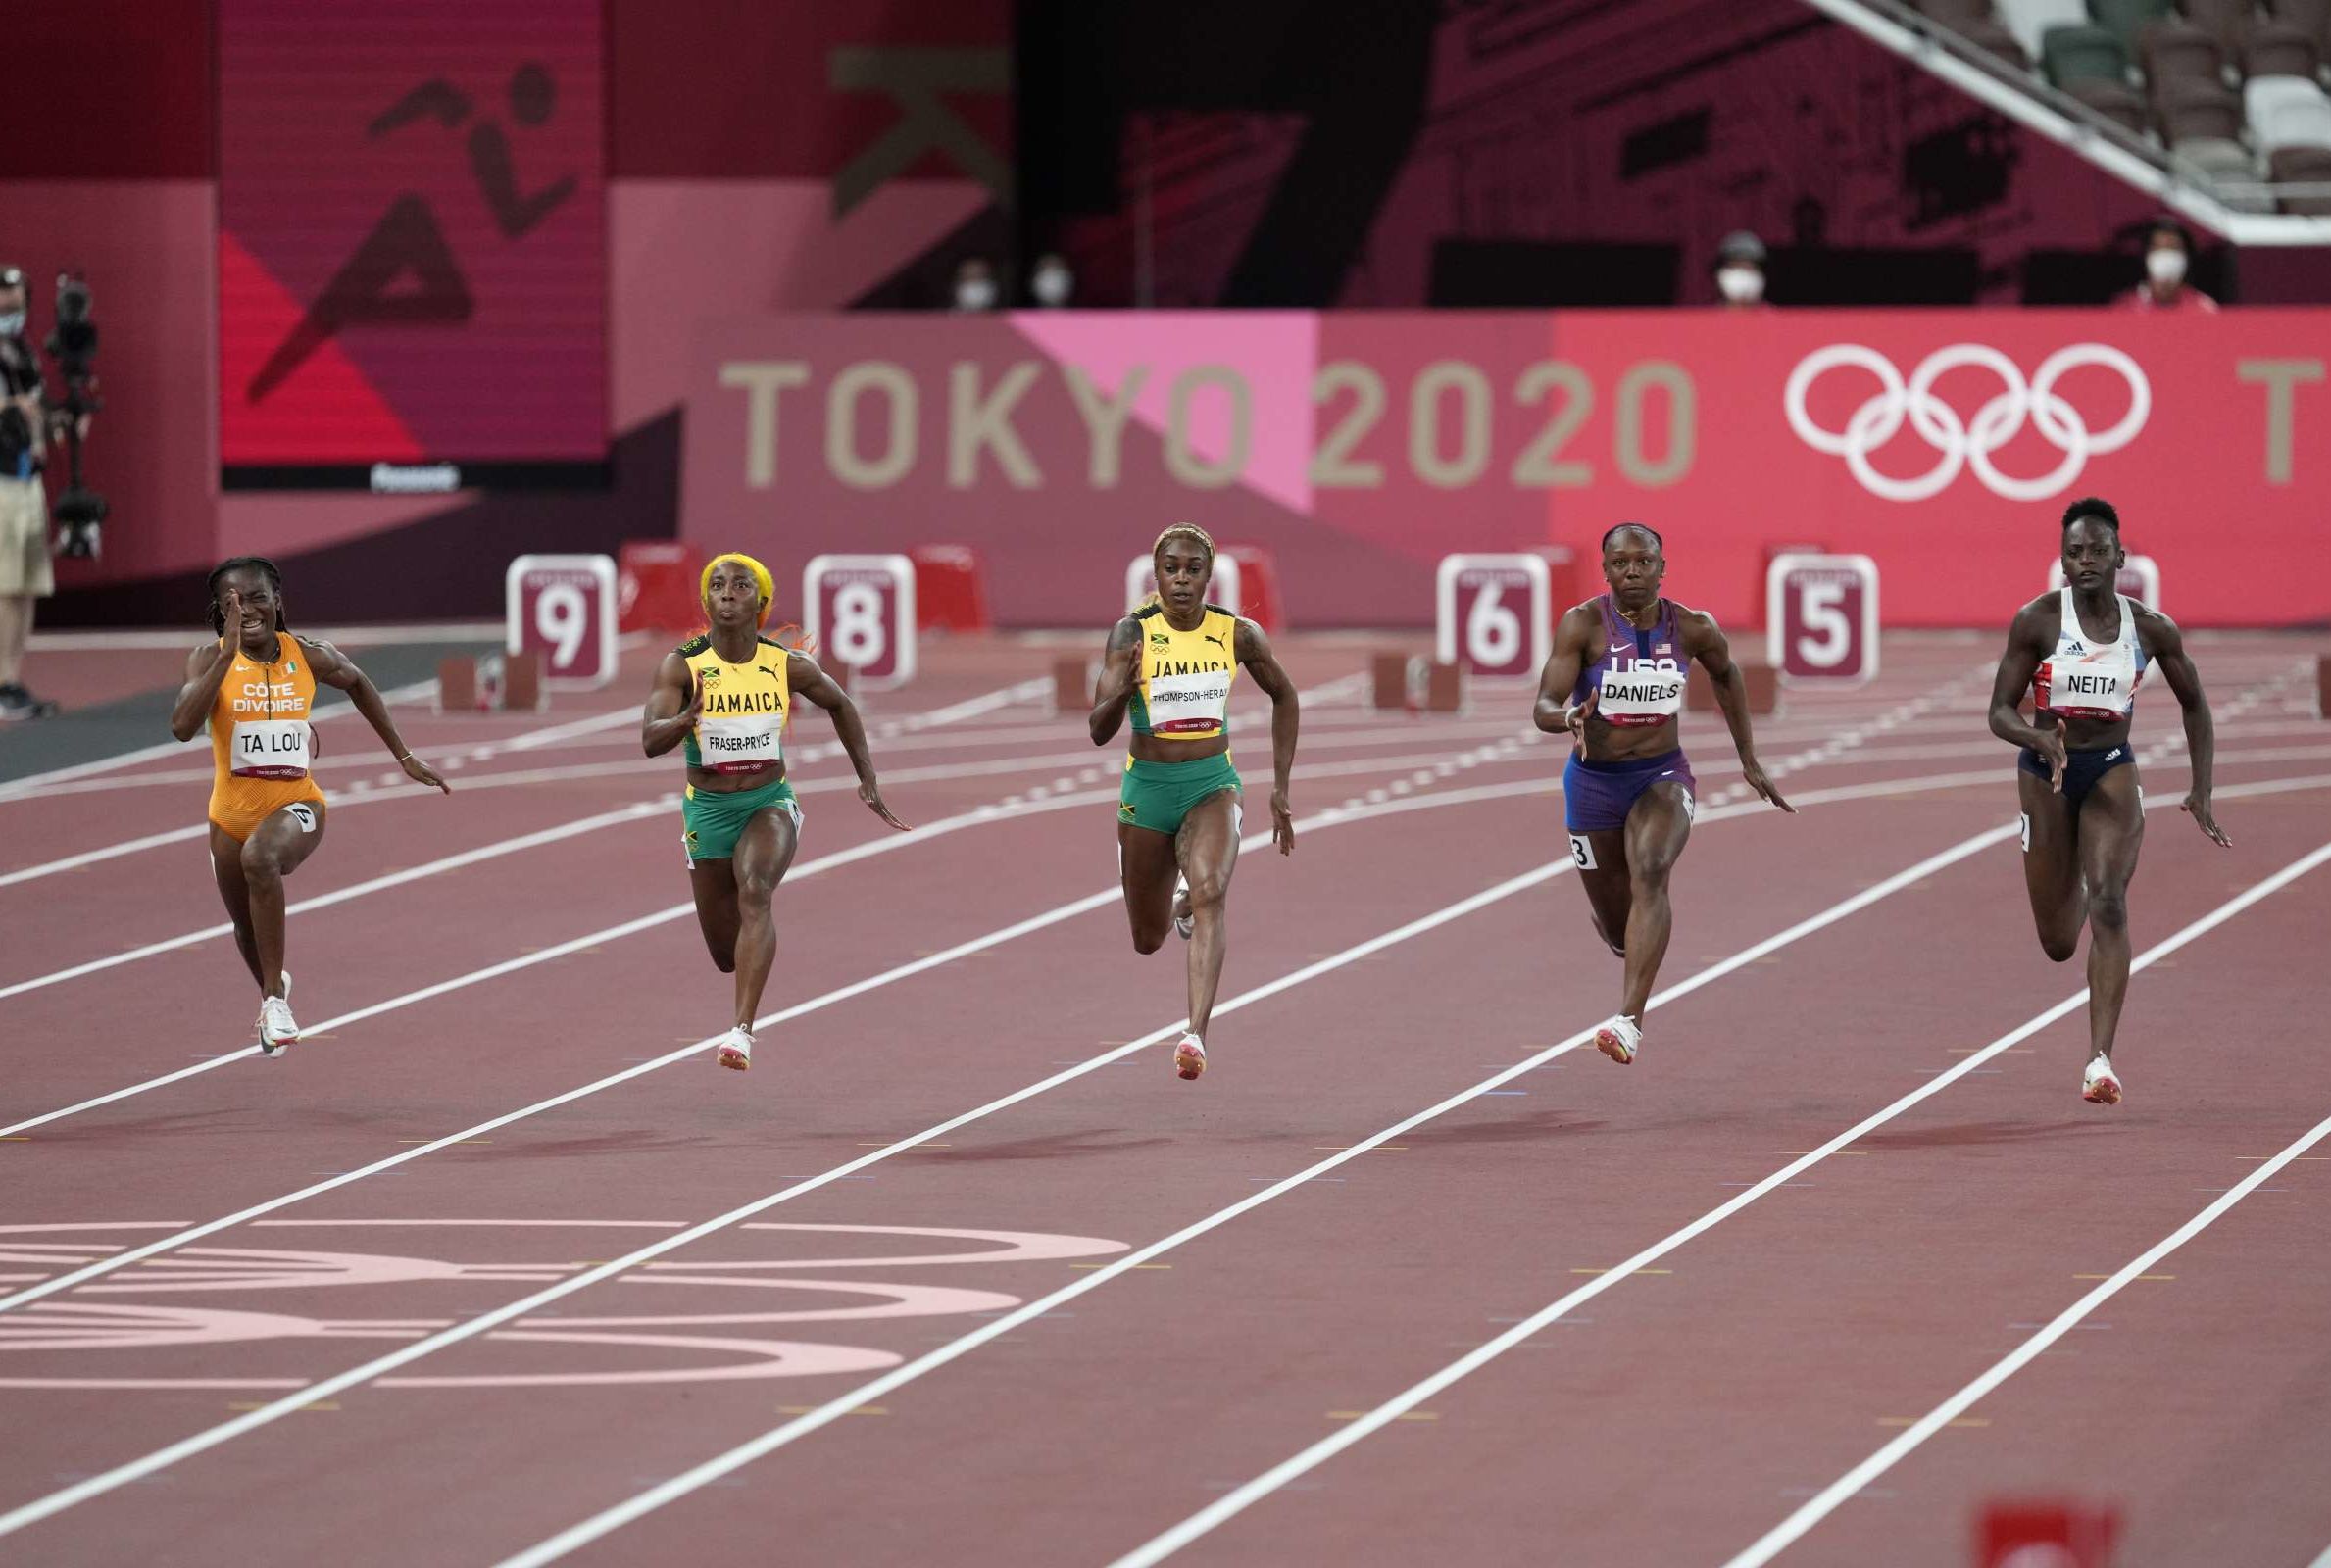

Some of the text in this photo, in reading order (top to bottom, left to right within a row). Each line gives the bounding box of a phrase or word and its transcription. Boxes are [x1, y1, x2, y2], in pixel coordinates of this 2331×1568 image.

[719, 359, 1697, 491] TOKYO 2020
[535, 586, 588, 668] 9
[831, 586, 884, 668] 8
[1466, 586, 1520, 668] 6
[1796, 585, 1851, 667] 5
[1605, 684, 1679, 702] DANIELS
[2068, 675, 2116, 695] NEITA
[706, 692, 783, 712] JAMAICA
[241, 733, 301, 753] TA LOU
[710, 733, 770, 752] FRASER-PRYCE
[1572, 838, 1587, 866] 3
